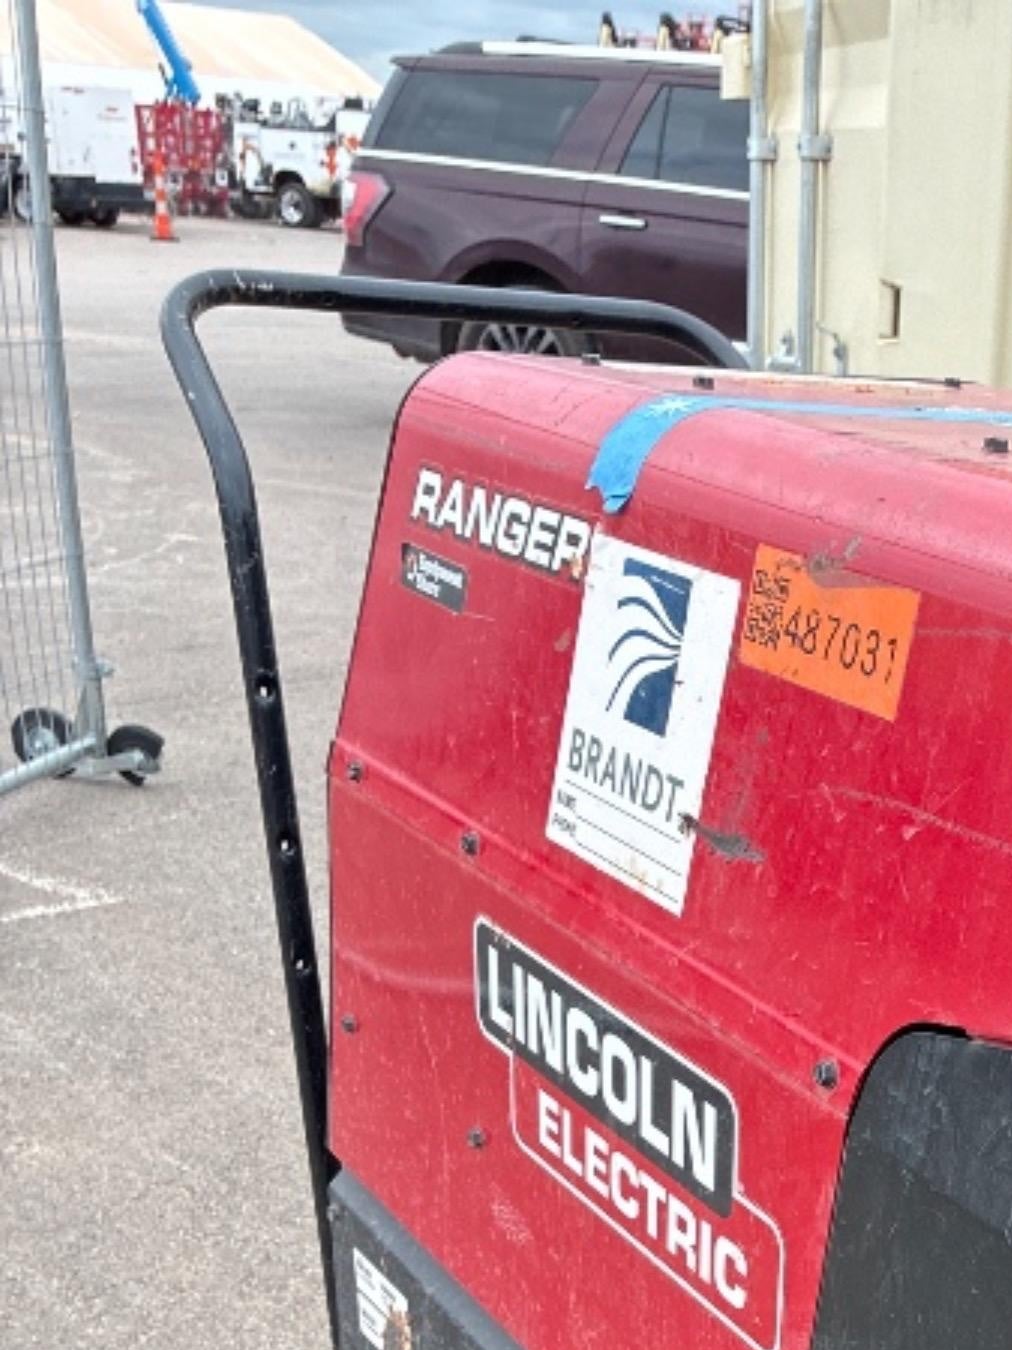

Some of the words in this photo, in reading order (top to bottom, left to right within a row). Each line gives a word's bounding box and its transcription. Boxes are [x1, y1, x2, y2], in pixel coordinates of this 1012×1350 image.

[410, 467, 592, 580] RANGER
[784, 606, 897, 685] 487031
[567, 728, 685, 823] BRANDT
[487, 944, 719, 1193] LINCOLN
[537, 1088, 749, 1309] ELECTRIC
